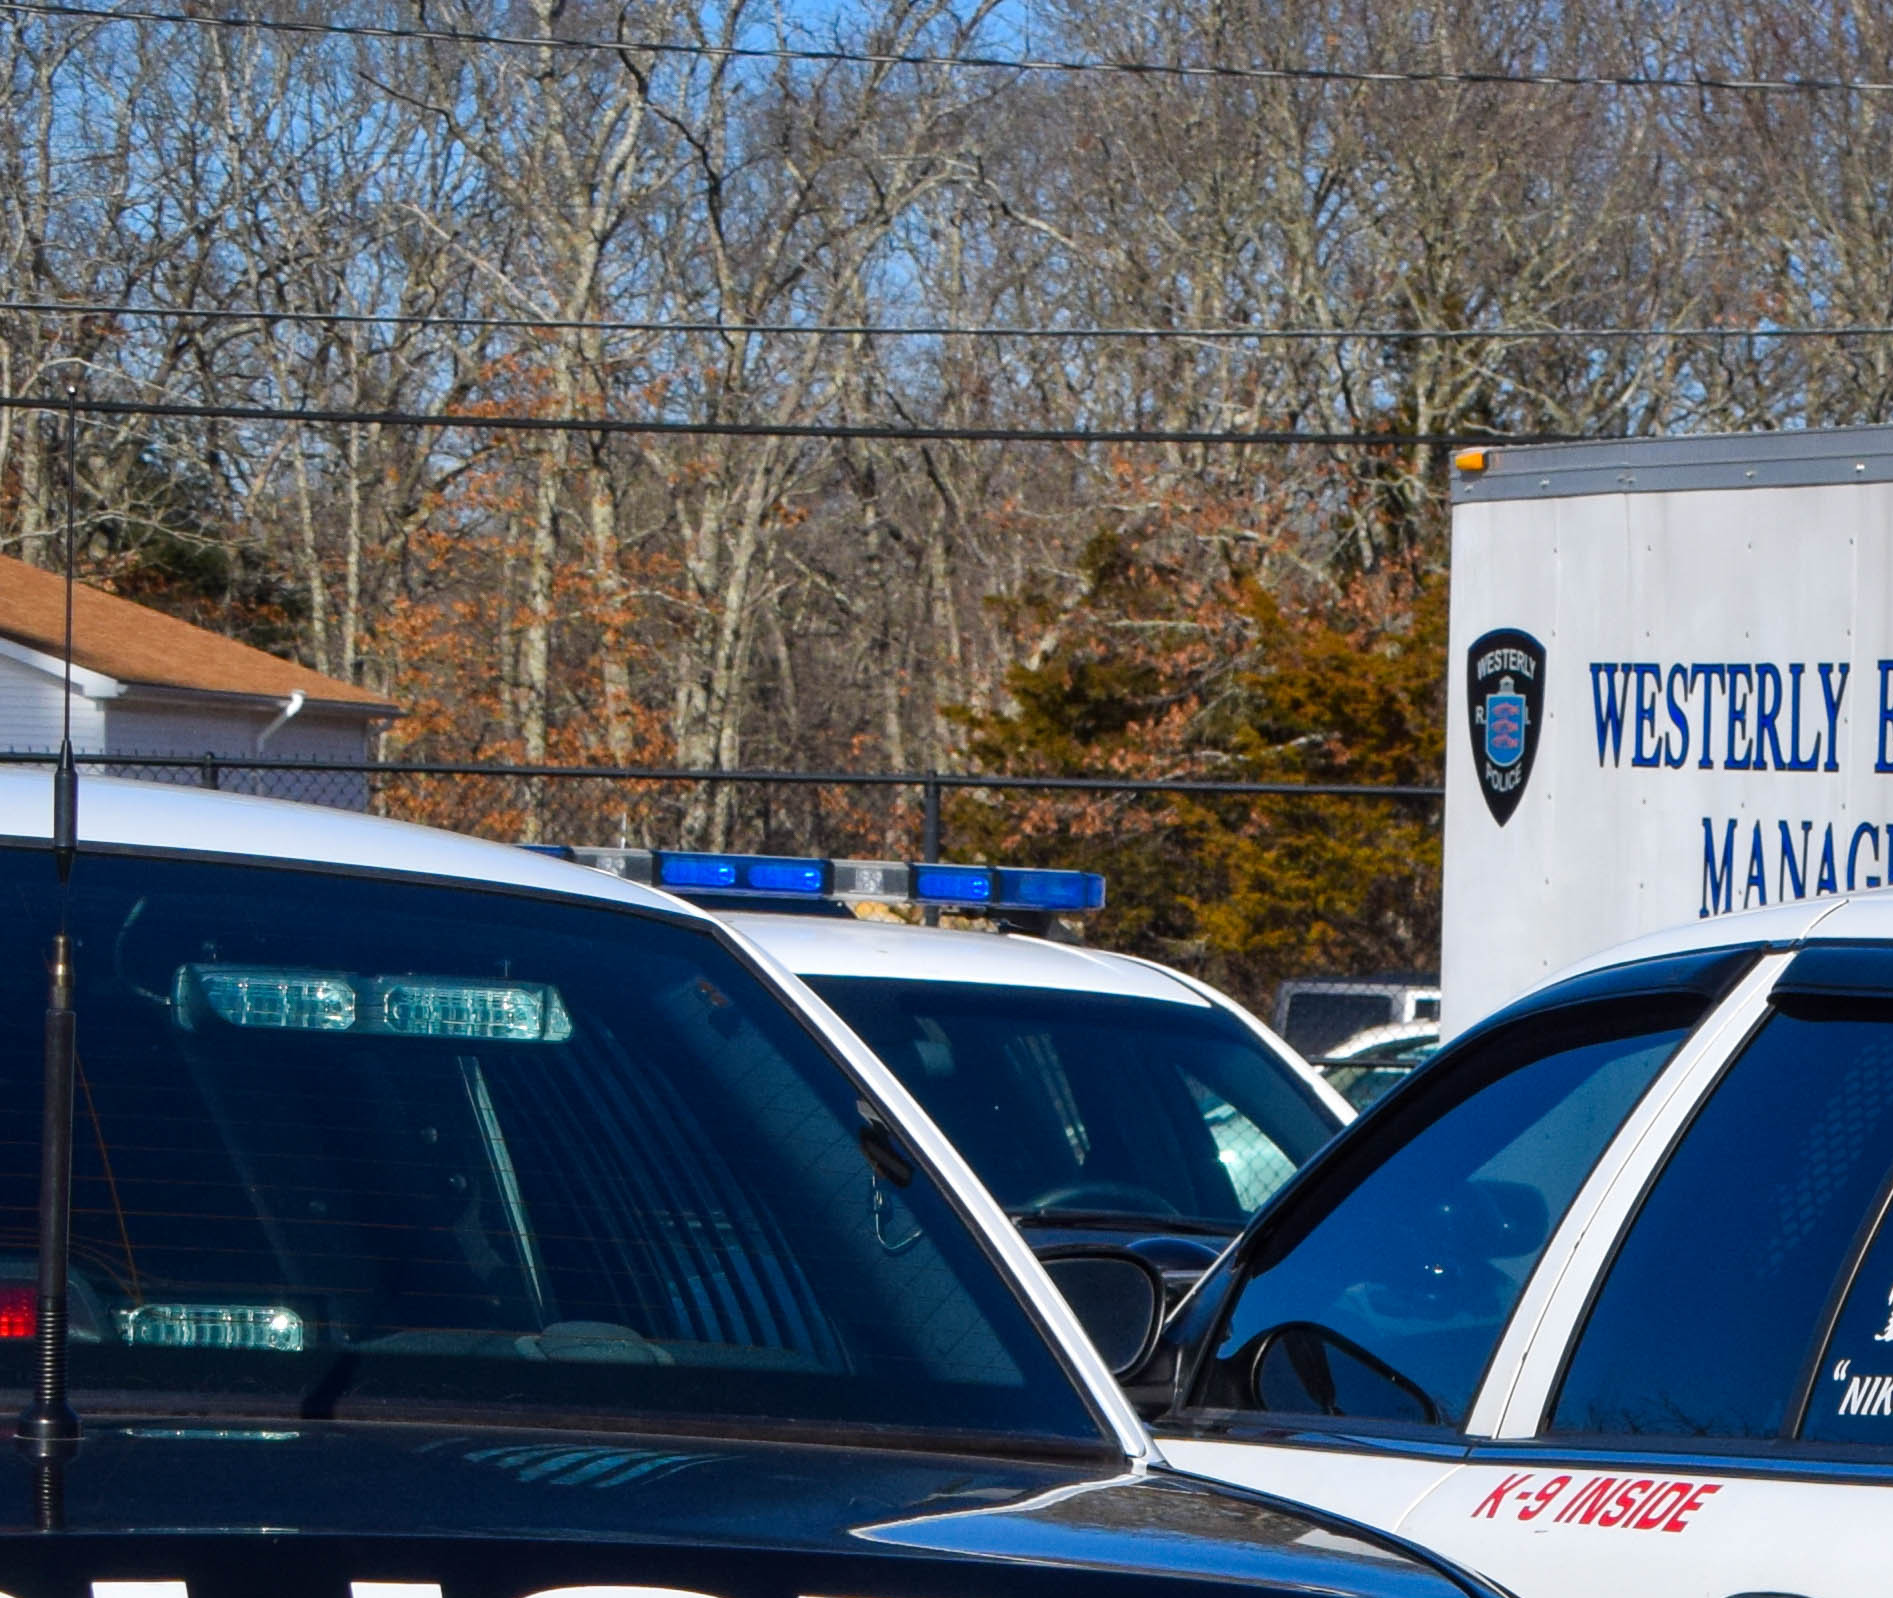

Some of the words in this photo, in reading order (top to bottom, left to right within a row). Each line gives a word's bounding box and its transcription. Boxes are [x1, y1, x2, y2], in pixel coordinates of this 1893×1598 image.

[1476, 649, 1537, 680] WESTERLY
[1590, 662, 1850, 773] WESTERLY
[1485, 763, 1522, 791] POLICE
[1470, 1473, 1573, 1521] K-9
[1552, 1476, 1724, 1533] INSIDE
